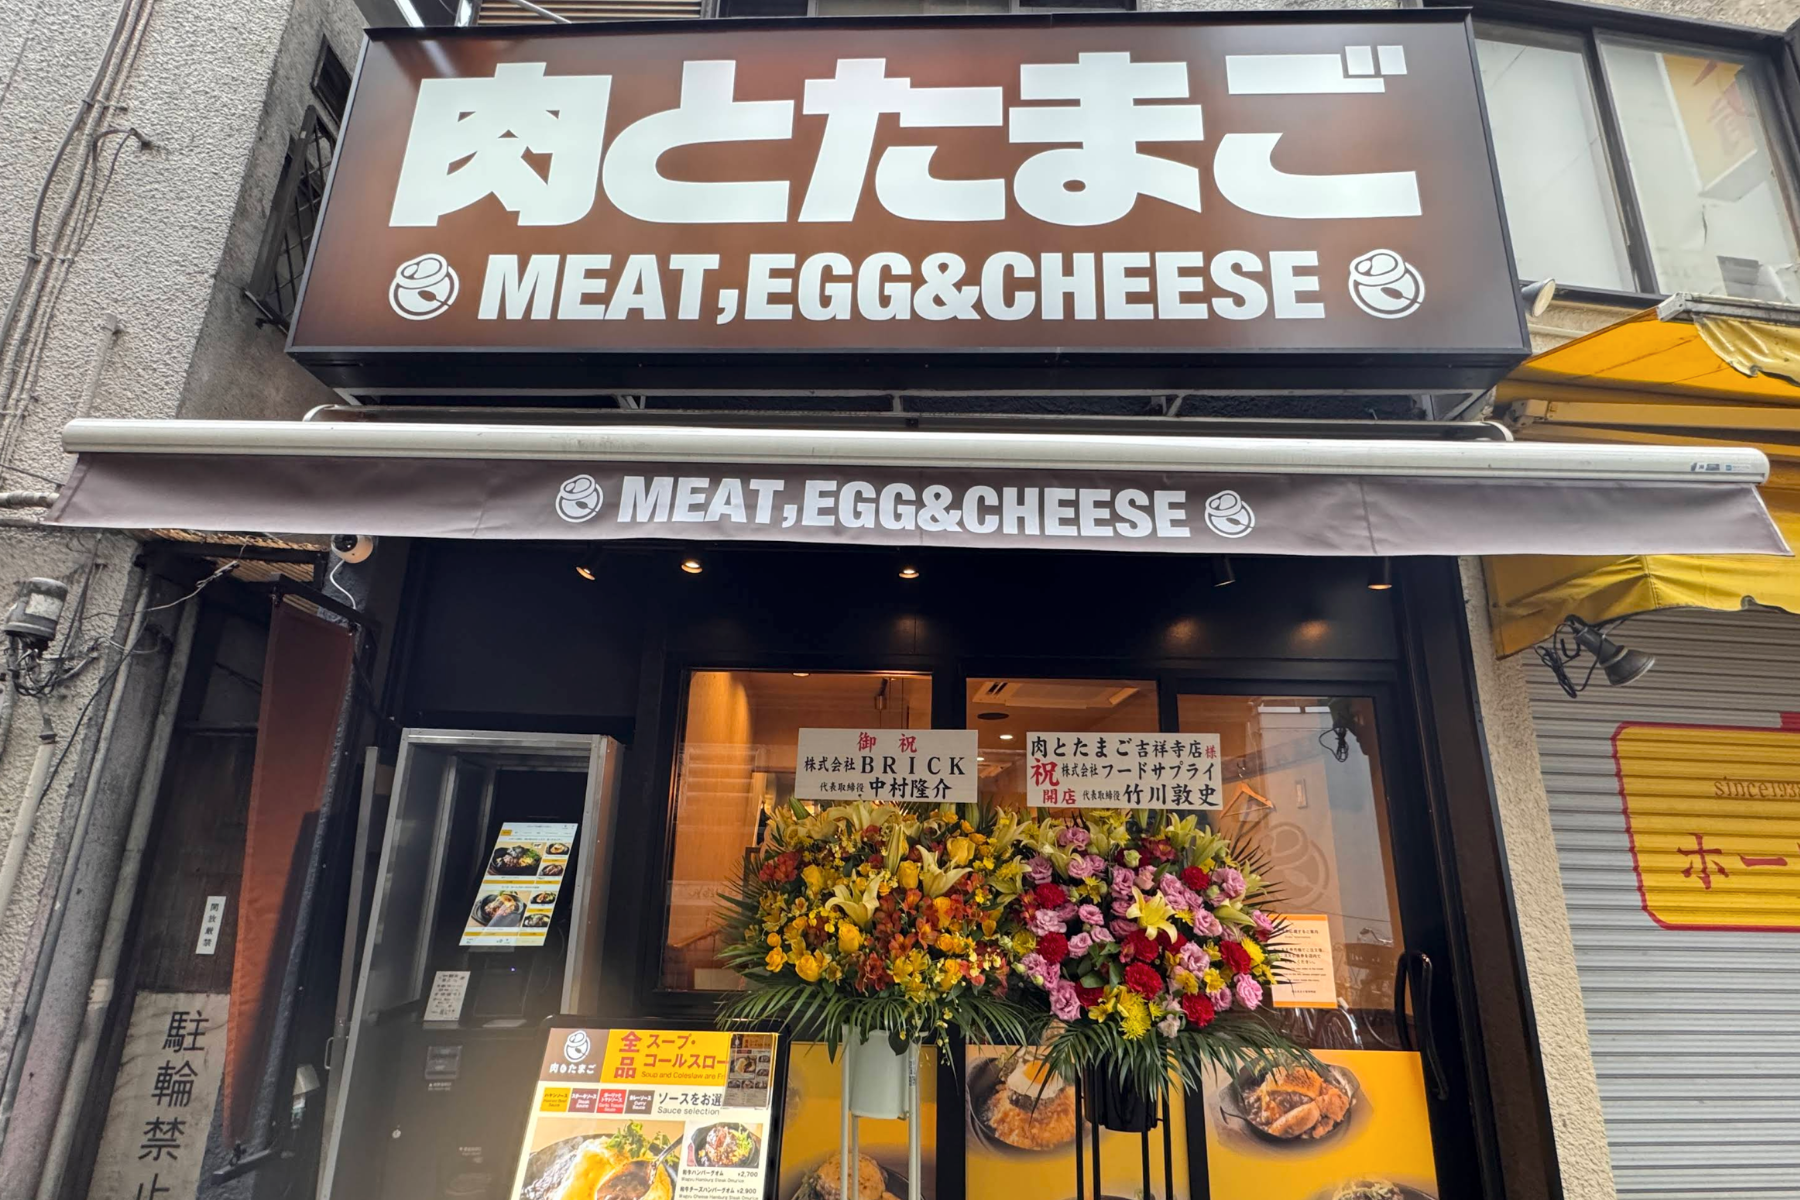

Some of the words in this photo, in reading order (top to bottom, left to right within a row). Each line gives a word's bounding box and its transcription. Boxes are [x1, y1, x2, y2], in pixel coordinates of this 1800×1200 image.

[389, 45, 1422, 227] 肉とたまご
[477, 250, 1326, 325] MEAT,EGG&CHEESE
[617, 476, 1191, 538] MEAT,EGG&CHEESE
[1676, 832, 1800, 890] ホー
[129, 1010, 210, 1200] 駐輪禁止
[641, 1071, 658, 1079] Soup
[657, 1106, 682, 1114] Sauce
[684, 1107, 720, 1115] selection
